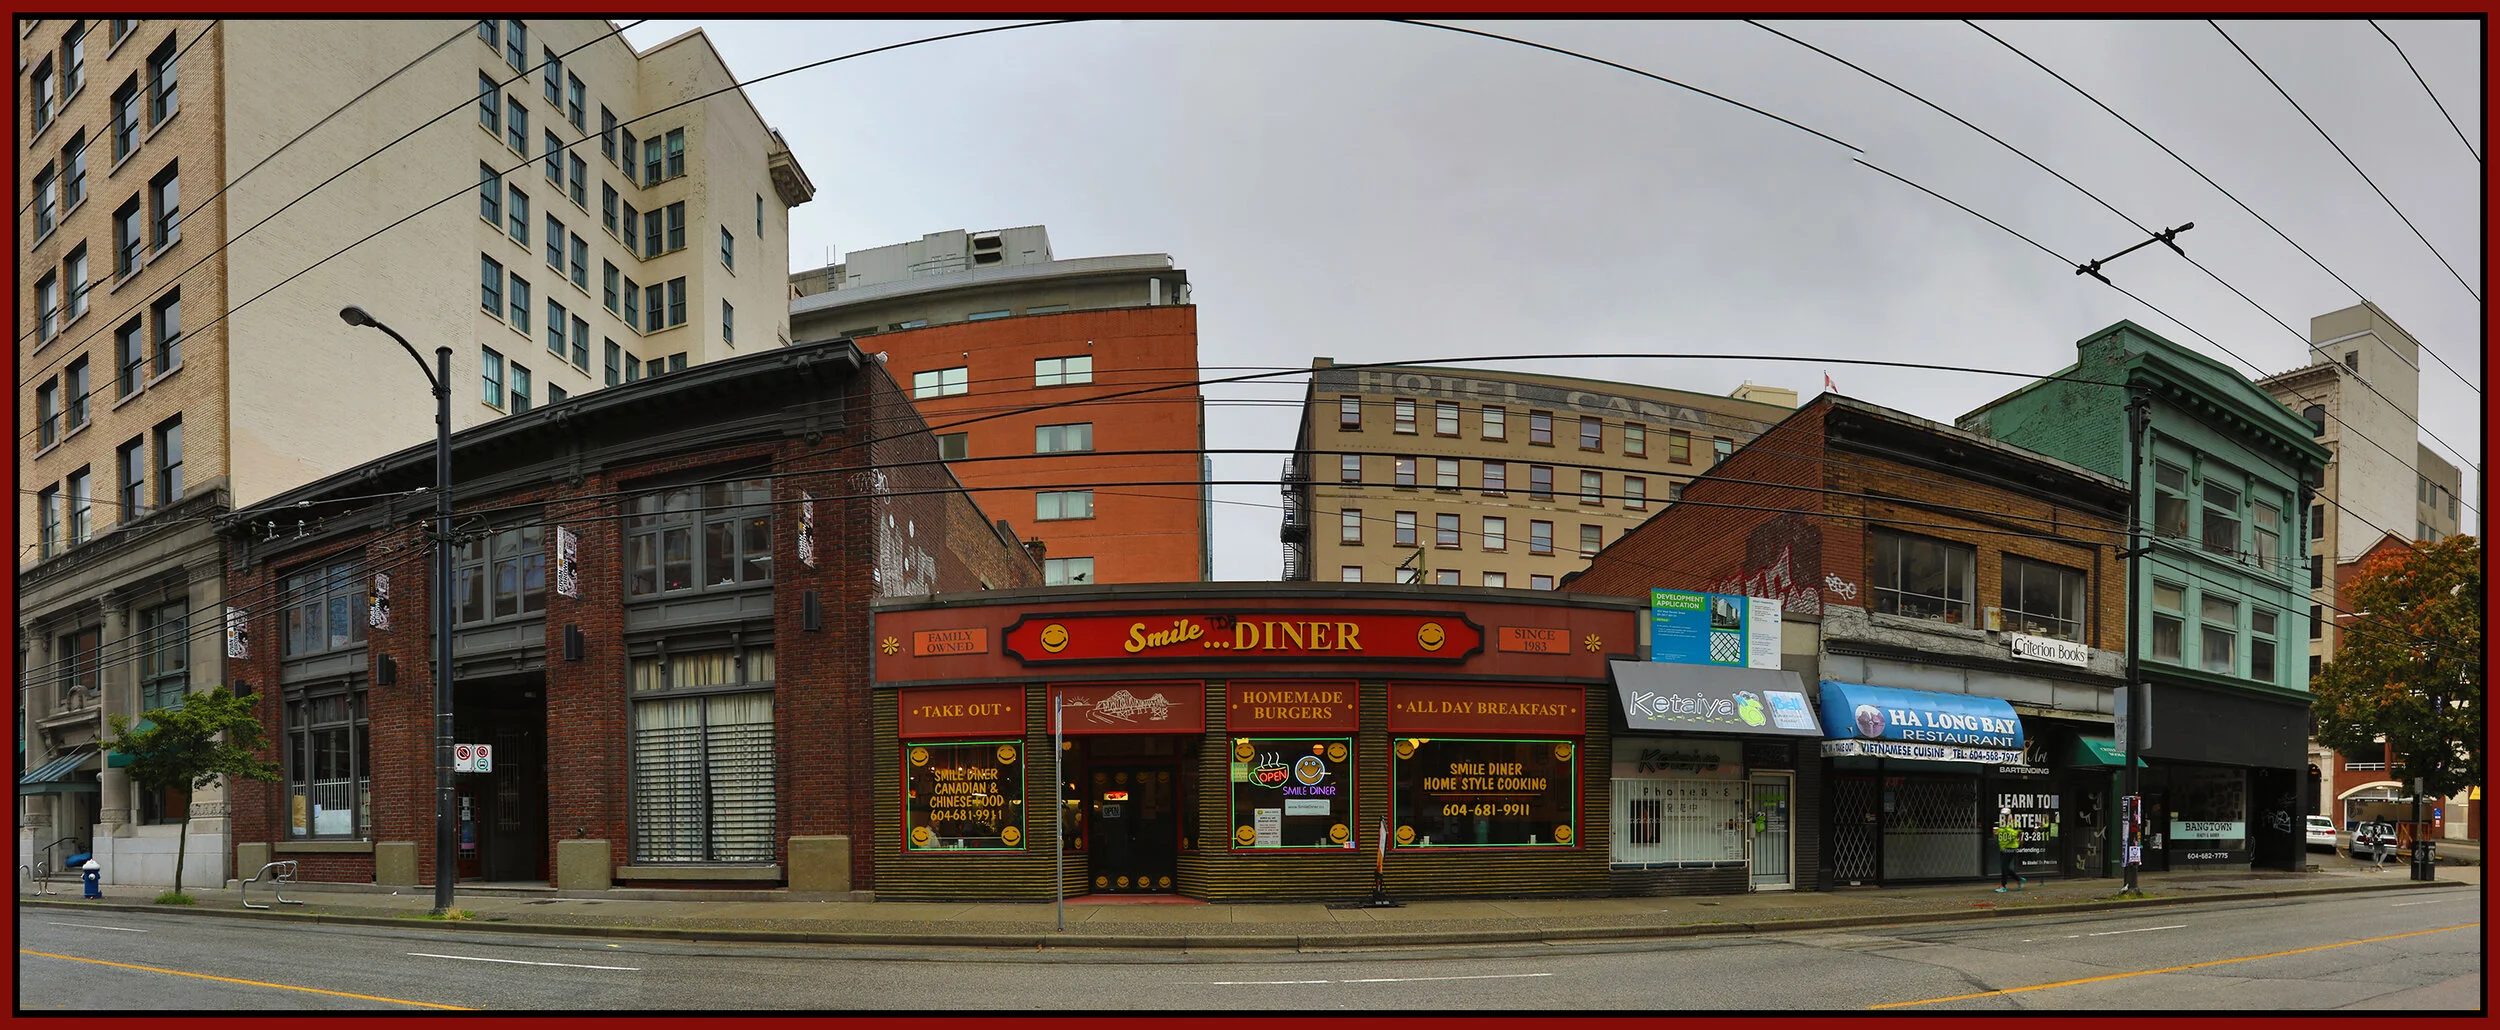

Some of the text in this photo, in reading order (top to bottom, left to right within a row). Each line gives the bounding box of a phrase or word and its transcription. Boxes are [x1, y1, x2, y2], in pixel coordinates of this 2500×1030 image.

[1358, 371, 1526, 404] HOTEL
[1656, 593, 1704, 603] DEVELOPMENT
[1656, 600, 1700, 609] APPLICATION
[928, 631, 972, 642] FAMILY
[1124, 619, 1204, 652] Smile
[1514, 629, 1555, 641] SINCE
[927, 642, 974, 653] OWNED
[1524, 641, 1547, 652] 1983
[2013, 637, 2085, 662] Criterion Books
[1243, 691, 1343, 703] HOMEMADE
[1772, 696, 1802, 711] Bell
[922, 703, 1001, 717] TAKE OUT
[1406, 701, 1567, 716] ALL DAY BREAKFAST
[1630, 691, 1734, 718] Ketaiya
[1254, 706, 1332, 719] BURGERS
[1888, 709, 2016, 735] HA LONG BAY
[1903, 729, 2014, 747] RESTAURANT
[1861, 744, 2019, 763] VIETNAMESE CUISINE TEL: 604-568-7976
[934, 768, 998, 782] SMILE DINER
[1260, 769, 1287, 782] OPEN
[1450, 763, 1522, 775] SMILE DINER
[1999, 766, 2050, 775] BARTENDING
[934, 782, 998, 795] CANADIAN &
[1424, 777, 1547, 791] HOME STYLE COOKING
[1282, 786, 1336, 796] SMILE DINER
[929, 795, 973, 808] CHINESE
[1998, 793, 2051, 808] LEARN TO
[930, 809, 1003, 821] 604-681-9911
[1443, 804, 1529, 816] 604-681-9911
[1999, 813, 2050, 828] BARTEND
[2185, 822, 2233, 831] BANGTOWN
[2187, 852, 2229, 860] 604-682-7775
